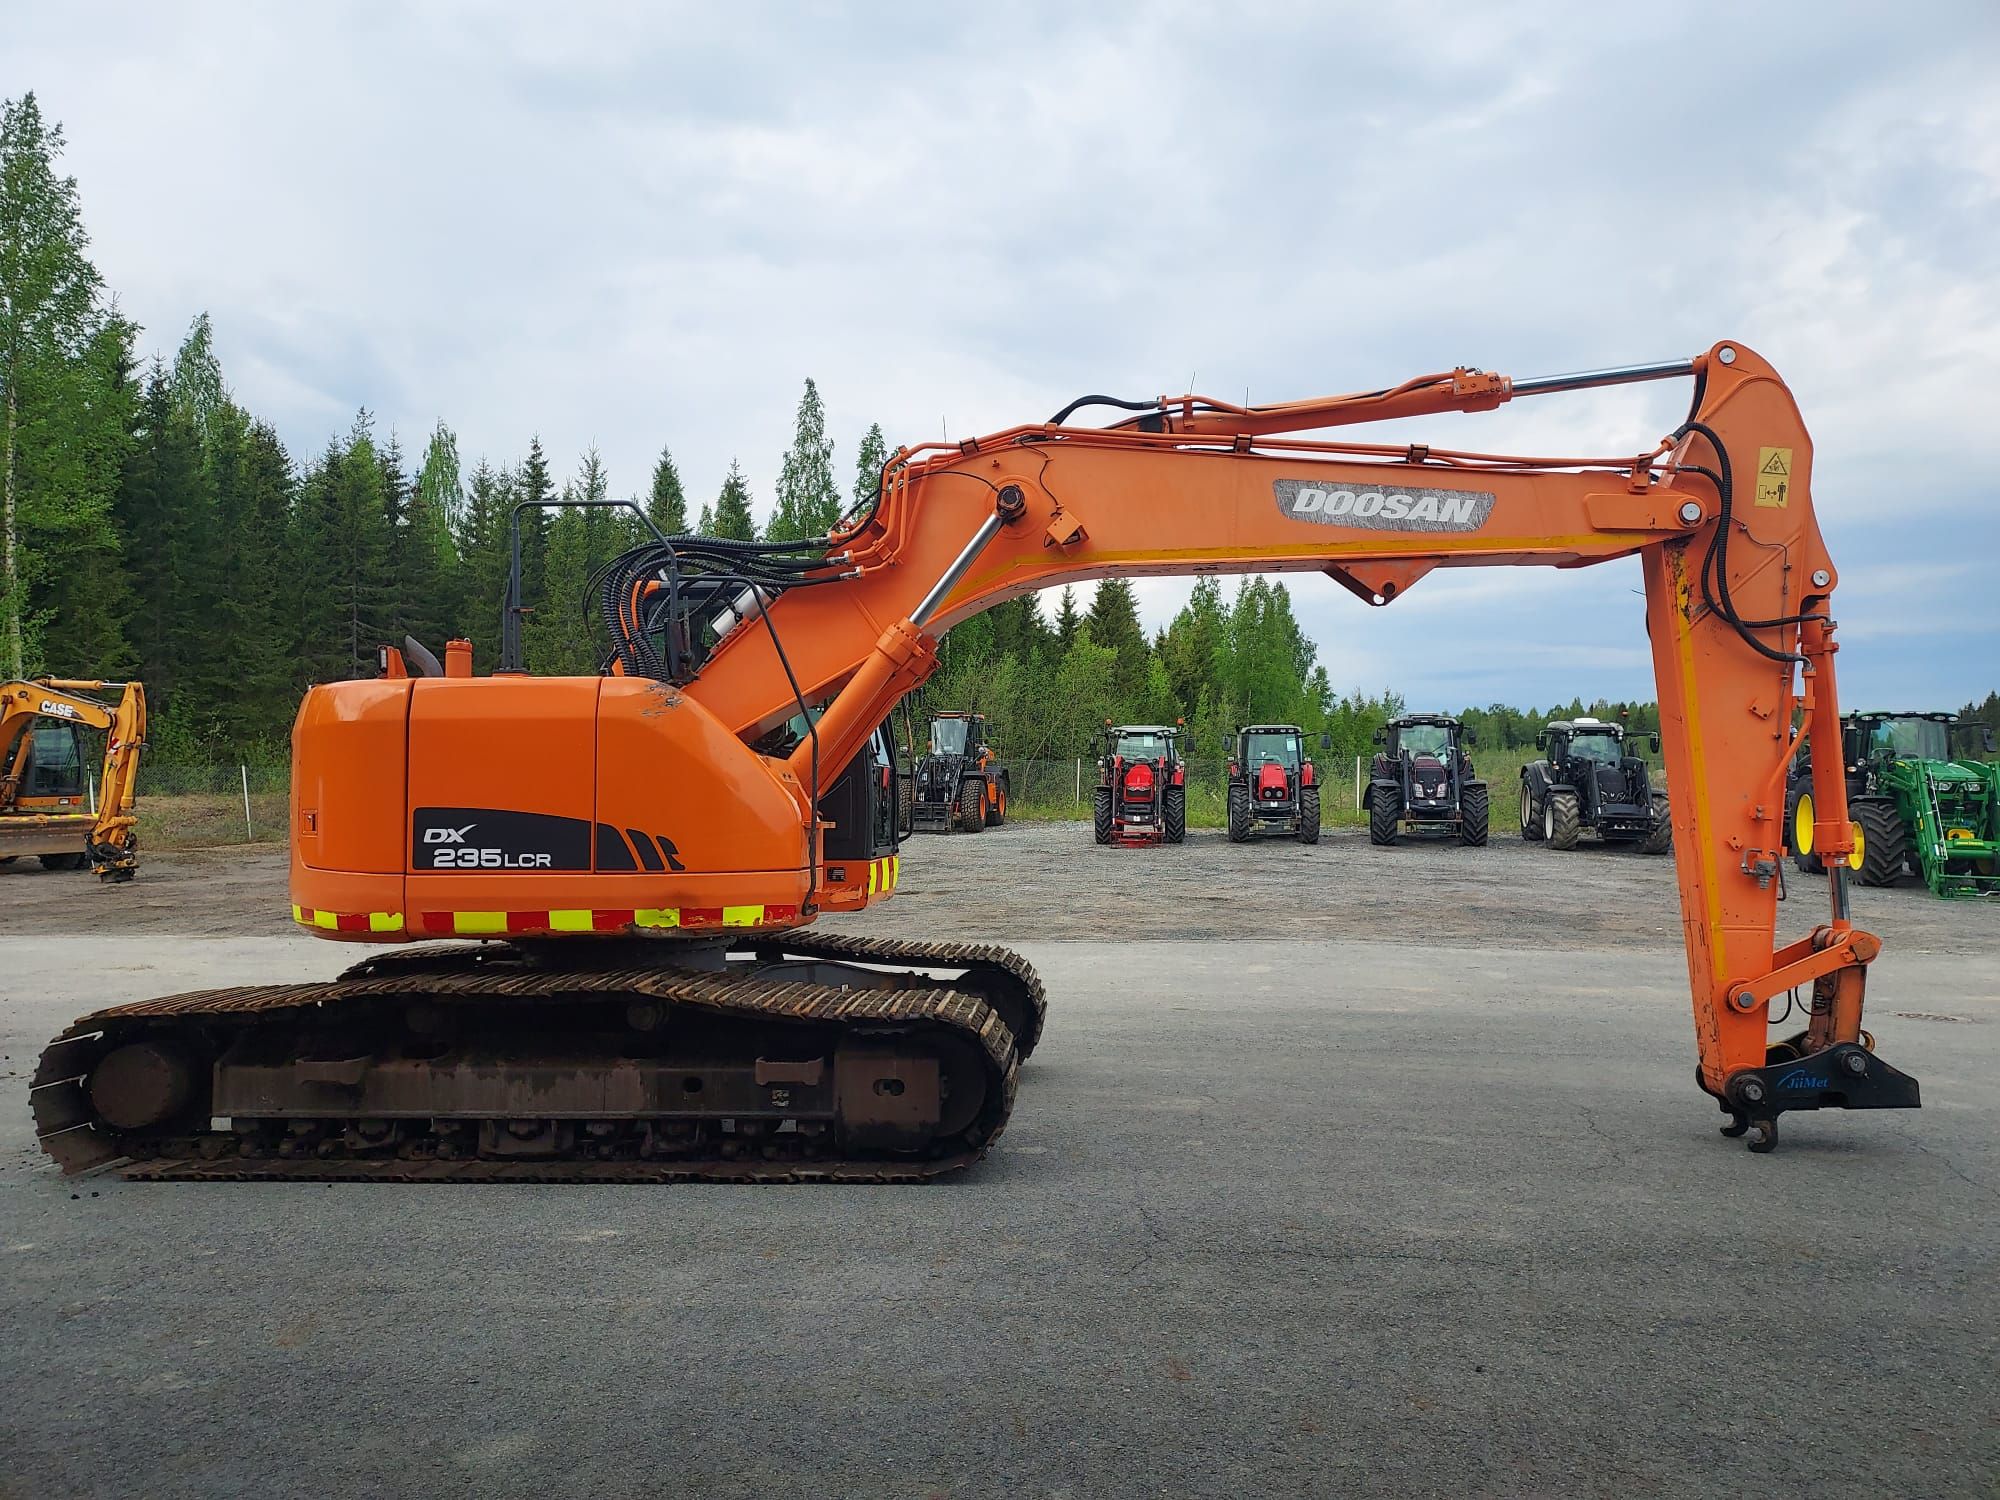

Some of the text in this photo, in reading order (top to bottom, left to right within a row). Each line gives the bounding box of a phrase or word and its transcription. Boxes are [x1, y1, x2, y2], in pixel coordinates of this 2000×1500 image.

[1292, 488, 1477, 523] DOOSAN
[41, 700, 74, 718] CASE
[423, 824, 478, 843] DX
[1787, 1077, 1829, 1089] JiiMet
